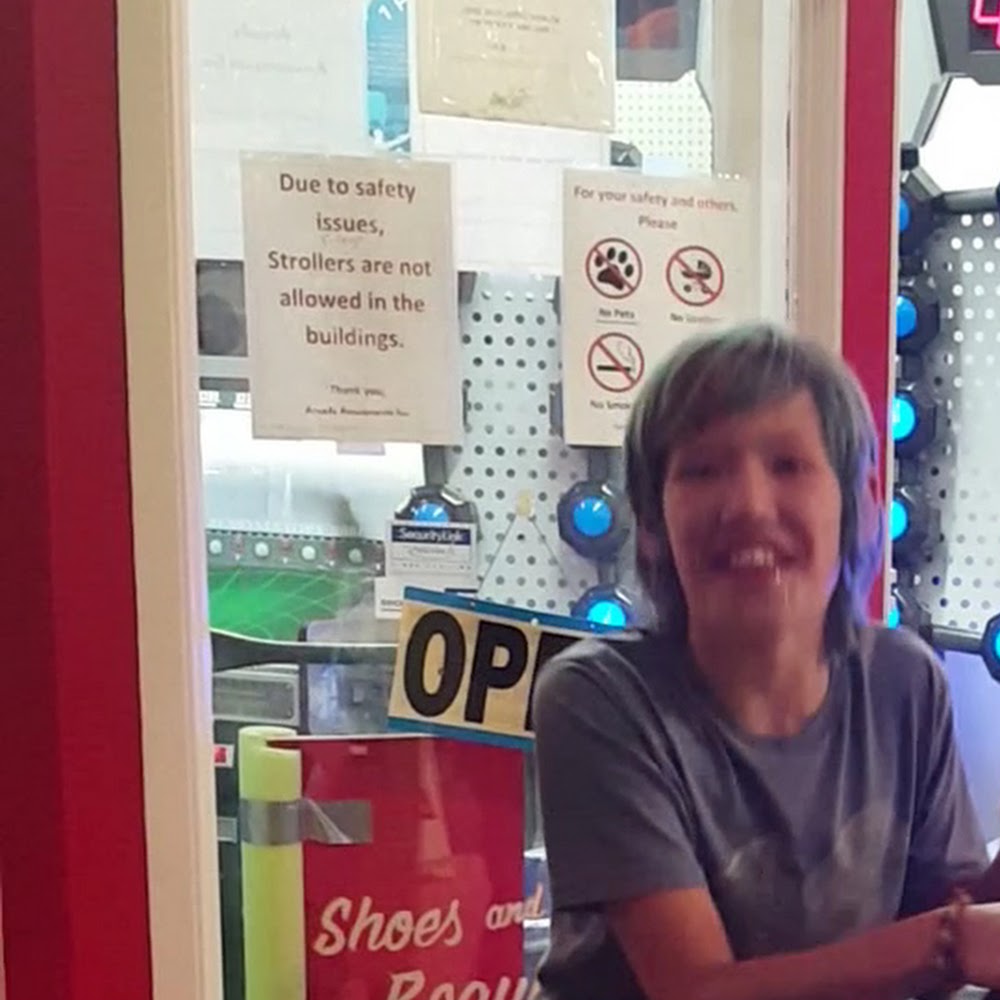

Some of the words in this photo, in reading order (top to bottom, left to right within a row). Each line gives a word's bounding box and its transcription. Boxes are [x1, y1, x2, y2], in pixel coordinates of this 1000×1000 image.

[279, 172, 321, 194] Due
[327, 177, 350, 195] to
[354, 178, 416, 204] safety
[573, 185, 594, 199] For
[597, 190, 627, 202] your
[630, 191, 668, 207] safety
[671, 195, 694, 208] and
[315, 212, 385, 237] issues,
[637, 215, 678, 230] Please
[267, 250, 355, 273] Strollers
[361, 257, 394, 275] are
[399, 260, 432, 277] not
[279, 288, 362, 310] allowed
[367, 291, 387, 311] in
[392, 293, 426, 313] the
[305, 325, 404, 351] buildings.
[313, 896, 463, 956] Shoes
[486, 882, 544, 930] and
